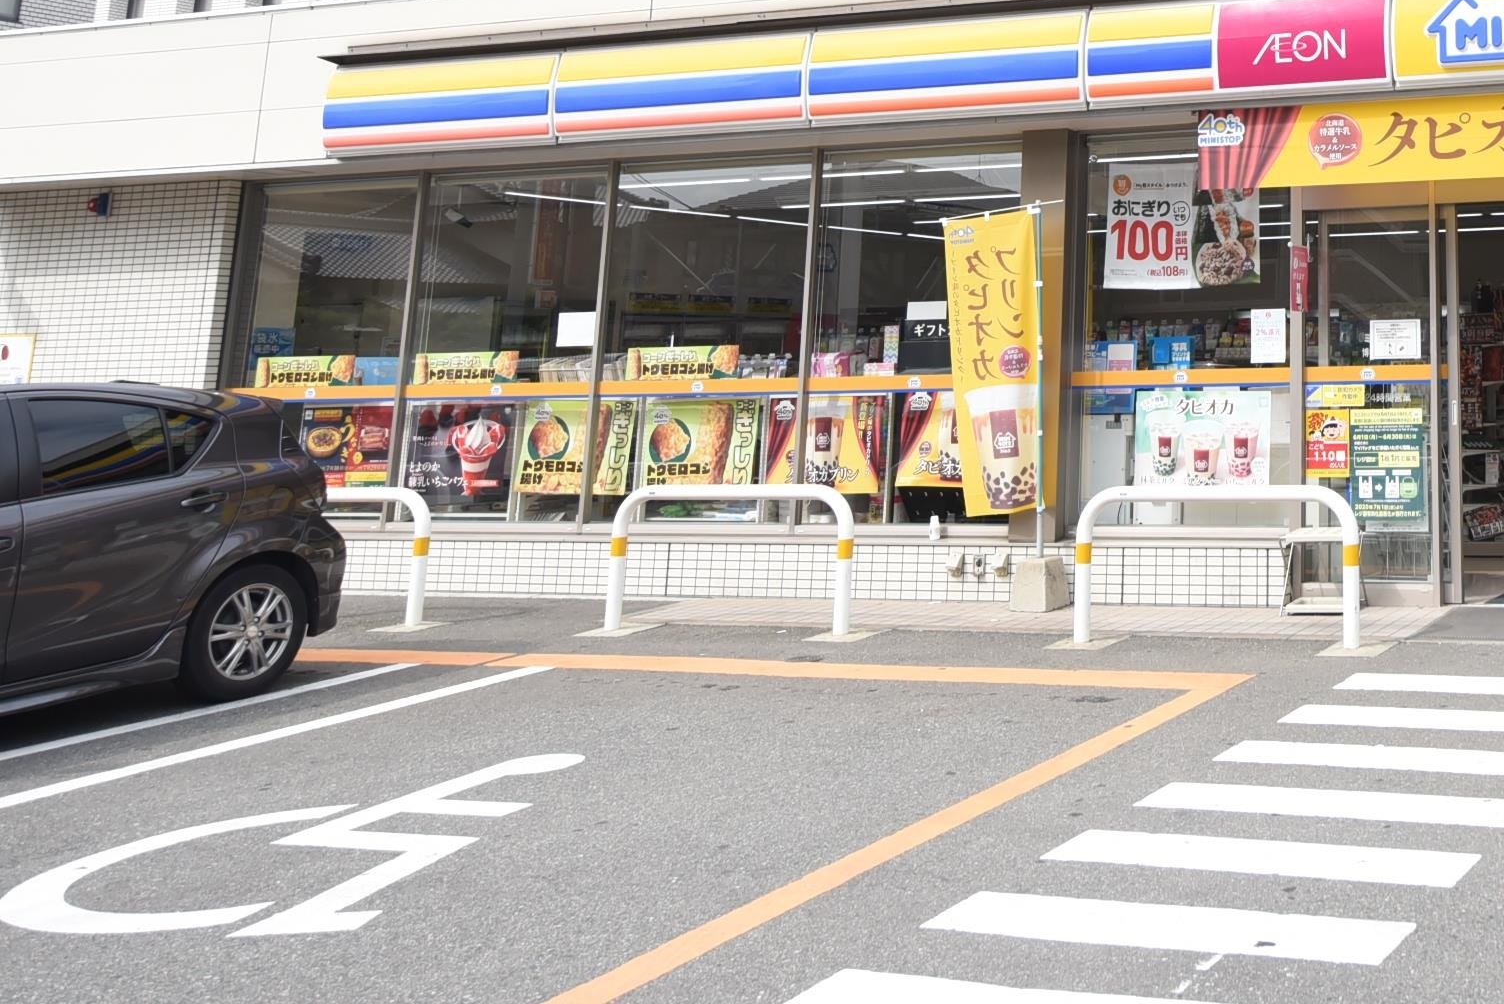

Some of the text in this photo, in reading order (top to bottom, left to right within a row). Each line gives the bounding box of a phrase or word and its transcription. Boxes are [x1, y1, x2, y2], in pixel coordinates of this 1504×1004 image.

[1325, 119, 1345, 127] 北海道
[1319, 127, 1351, 137] 特選牛乳
[1200, 135, 1241, 144] MINISTOP
[1313, 143, 1358, 153] カラメルソース
[1112, 199, 1171, 217] おにぎり
[1173, 205, 1186, 213] いつ
[1174, 214, 1186, 222] でも
[1110, 219, 1174, 261] 100
[1175, 246, 1188, 261] 円
[914, 324, 950, 337] ギフト
[409, 462, 440, 472] とよのか
